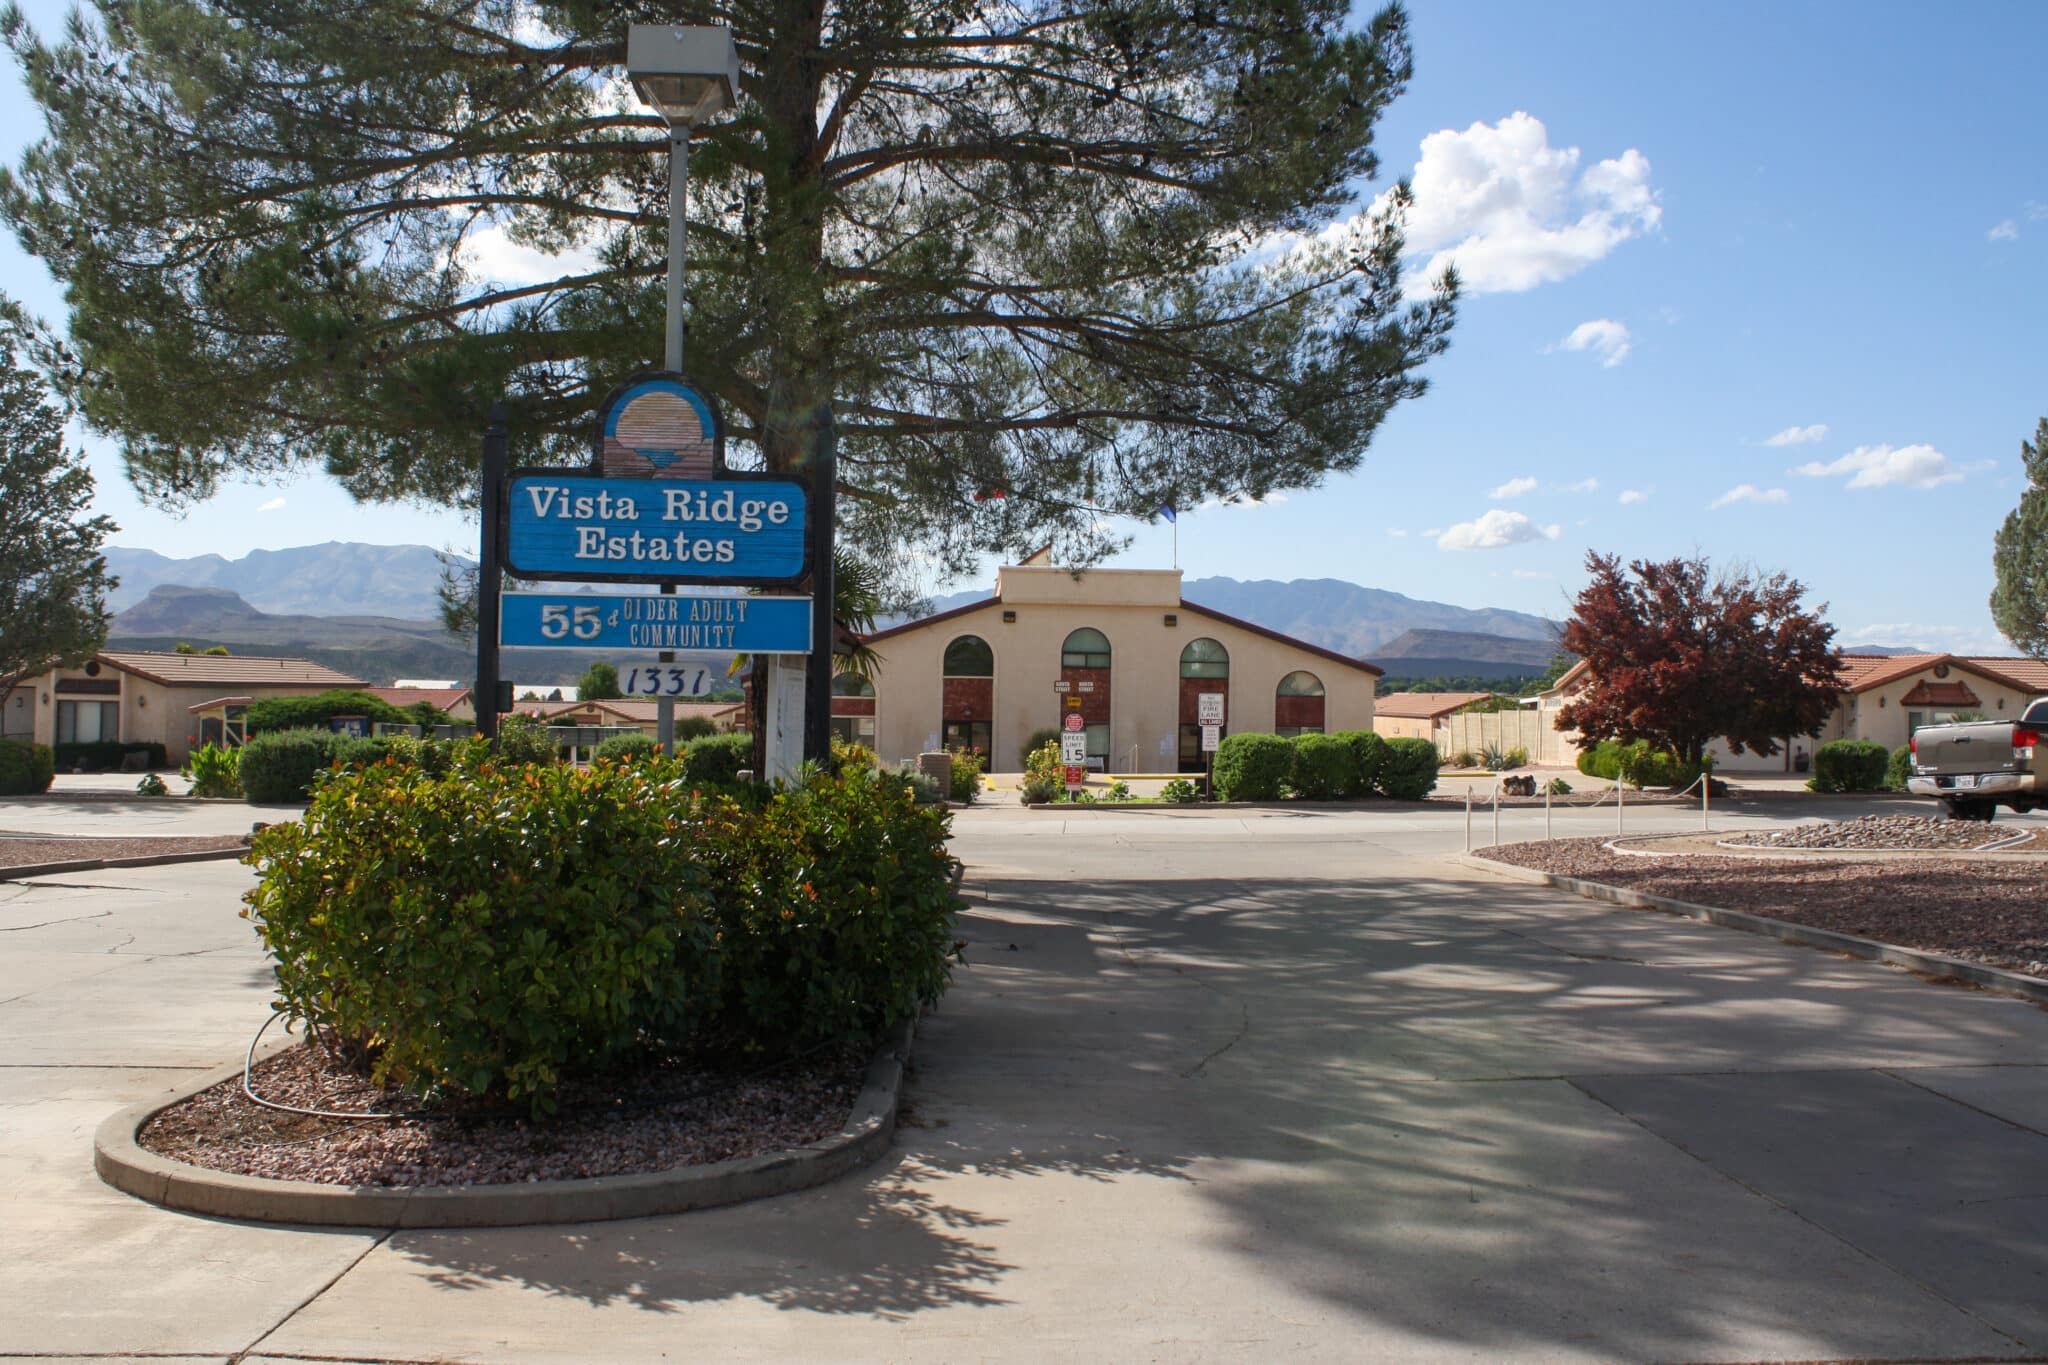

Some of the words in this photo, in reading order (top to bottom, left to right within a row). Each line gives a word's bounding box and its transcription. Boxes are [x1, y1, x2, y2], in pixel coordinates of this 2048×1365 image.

[526, 485, 640, 521] Vista
[661, 489, 790, 532] Ridge
[574, 526, 736, 563] Estates
[541, 604, 602, 641] 55
[689, 599, 748, 623] ADULT
[629, 623, 737, 648] COMMUNITY
[627, 667, 705, 695] 1331
[1065, 749, 1085, 761] 15
